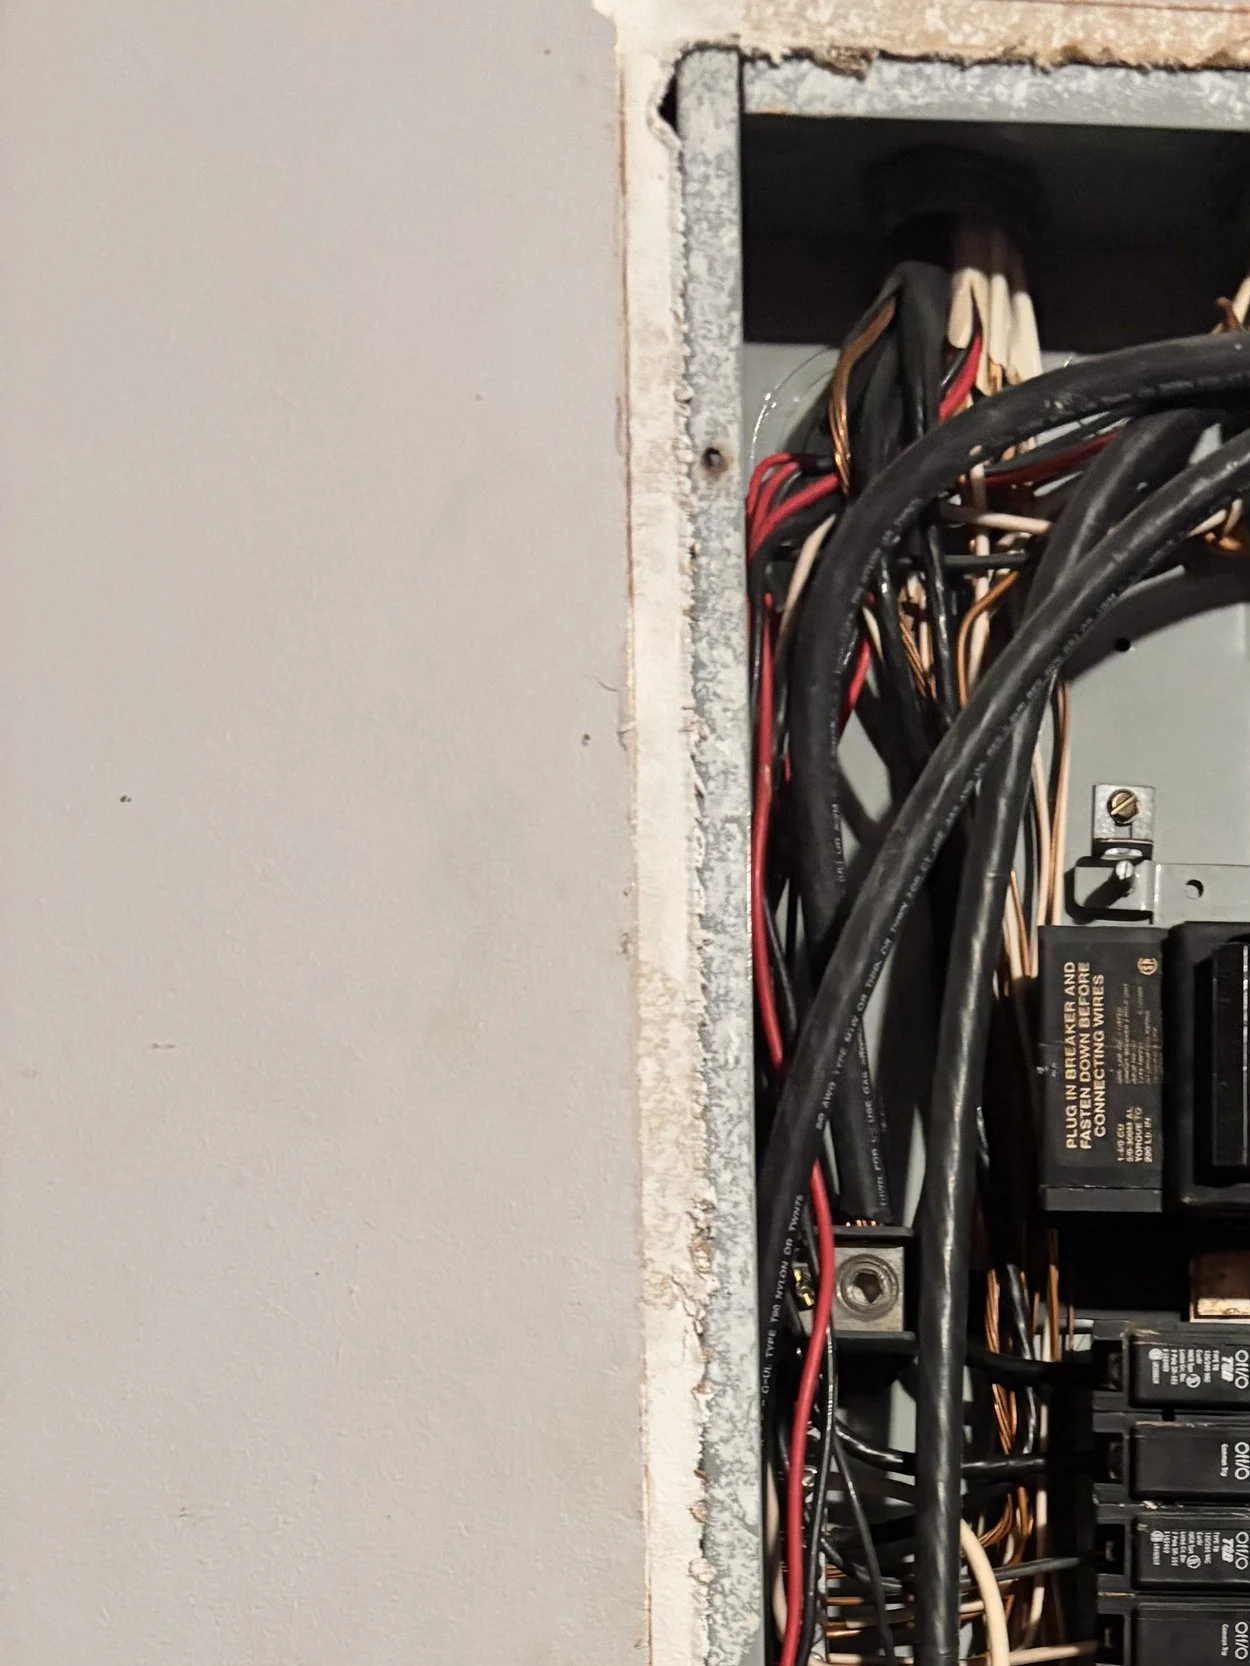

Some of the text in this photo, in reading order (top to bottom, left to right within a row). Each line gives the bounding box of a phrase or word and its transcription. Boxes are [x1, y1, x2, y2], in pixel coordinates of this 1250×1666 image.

[1064, 961, 1078, 1149] PLUG IN BREAKER AND
[1078, 961, 1092, 1150] FASTEN DOWN BEFORE
[1093, 974, 1107, 1138] CONNECTING WIRES
[765, 1329, 778, 1359] TYPE
[775, 1260, 789, 1299] NYLON
[783, 1238, 794, 1256] OR
[1234, 1350, 1249, 1389] Off/O
[1235, 1442, 1250, 1480] Off/O
[1234, 1531, 1249, 1570] Off/O
[1234, 1621, 1249, 1660] Off/O
